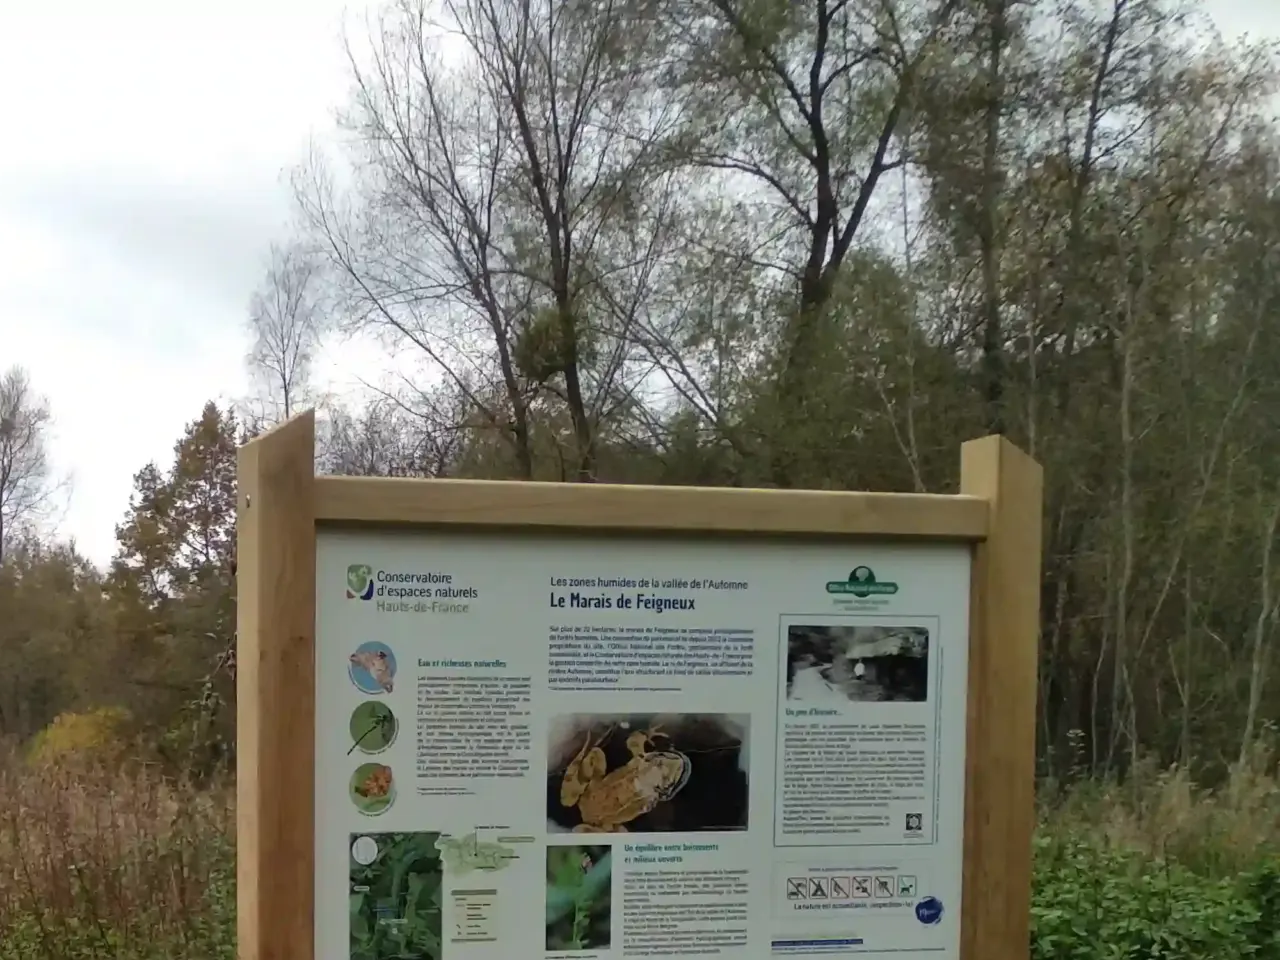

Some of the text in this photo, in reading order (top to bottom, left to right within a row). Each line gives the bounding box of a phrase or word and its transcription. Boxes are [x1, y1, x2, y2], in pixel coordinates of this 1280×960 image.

[377, 570, 452, 584] Conservatoire
[550, 577, 748, 590] Les zones humides de la vallée de l'Automne
[377, 585, 478, 598] d'espaces naturels
[376, 601, 469, 613] Hauts-de-France
[550, 592, 695, 613] Le Marais de Feigneux
